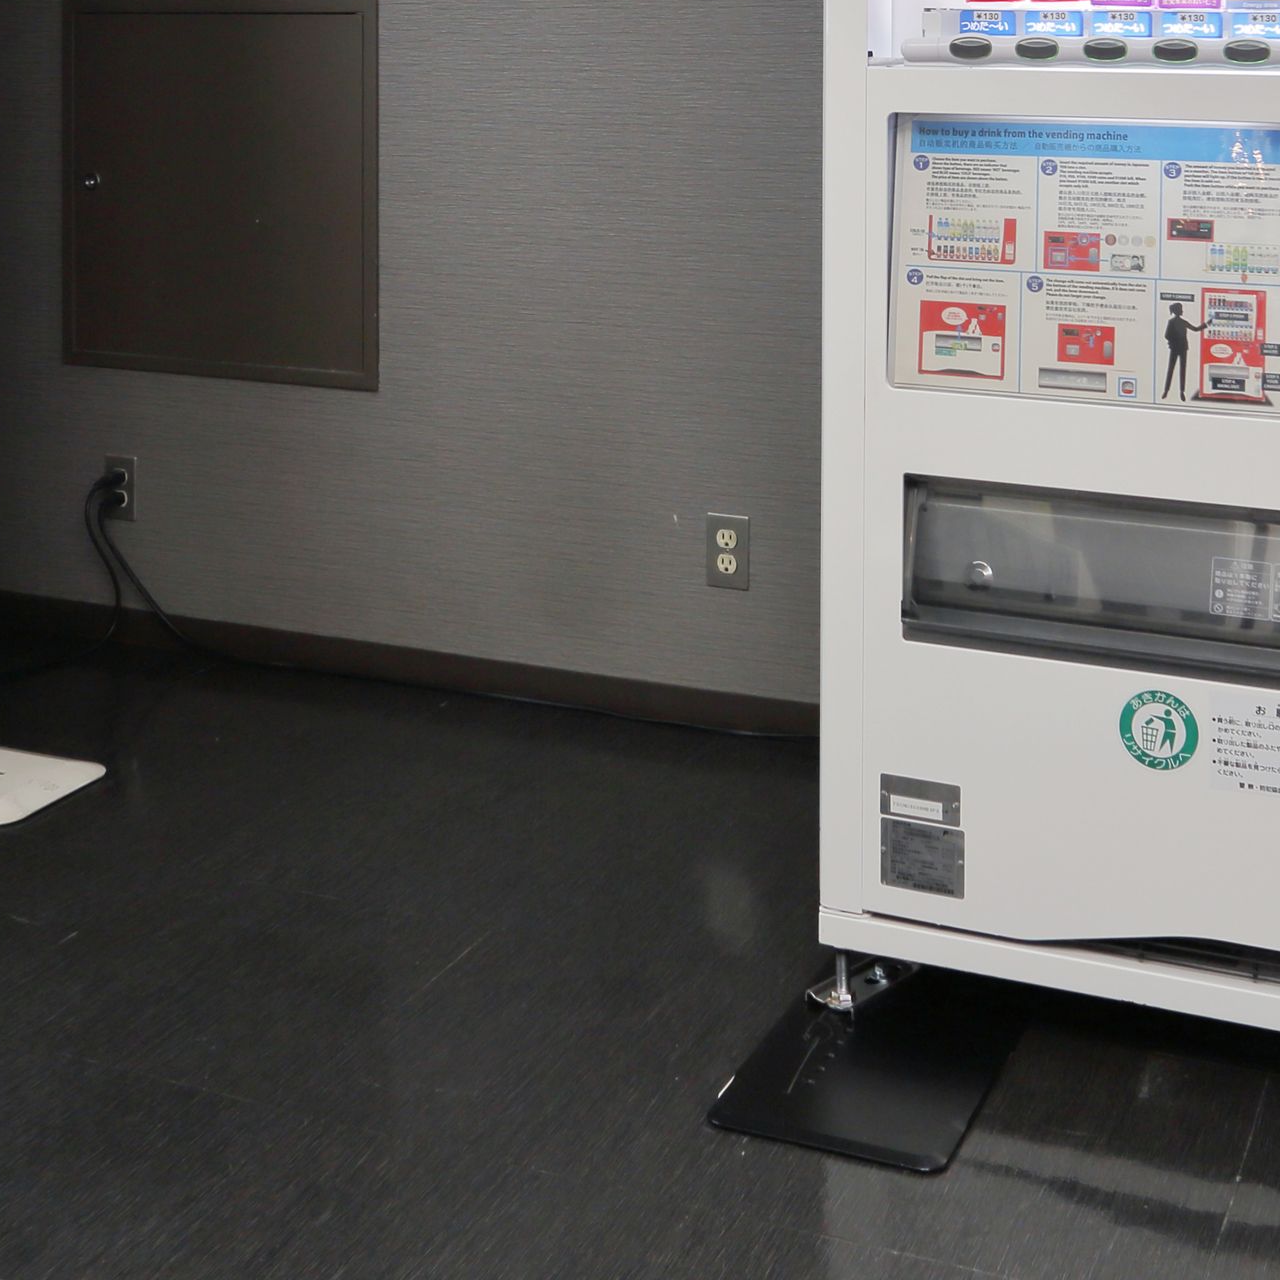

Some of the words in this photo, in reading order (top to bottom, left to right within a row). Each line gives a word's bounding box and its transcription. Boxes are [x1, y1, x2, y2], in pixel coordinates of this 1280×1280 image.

[1042, 12, 1066, 20] ¥130
[1110, 12, 1134, 21] ¥130
[1252, 14, 1277, 23] ¥130
[919, 127, 936, 136] How
[952, 128, 969, 139] buy
[978, 128, 1001, 138] drink
[1003, 129, 1026, 138] from
[1028, 130, 1044, 139] the
[1046, 131, 1084, 142] vending
[1087, 132, 1128, 141] machine
[1129, 692, 1190, 718] あきかんは
[1123, 734, 1191, 769] リサイクルへ
[1218, 769, 1244, 778] ください。
